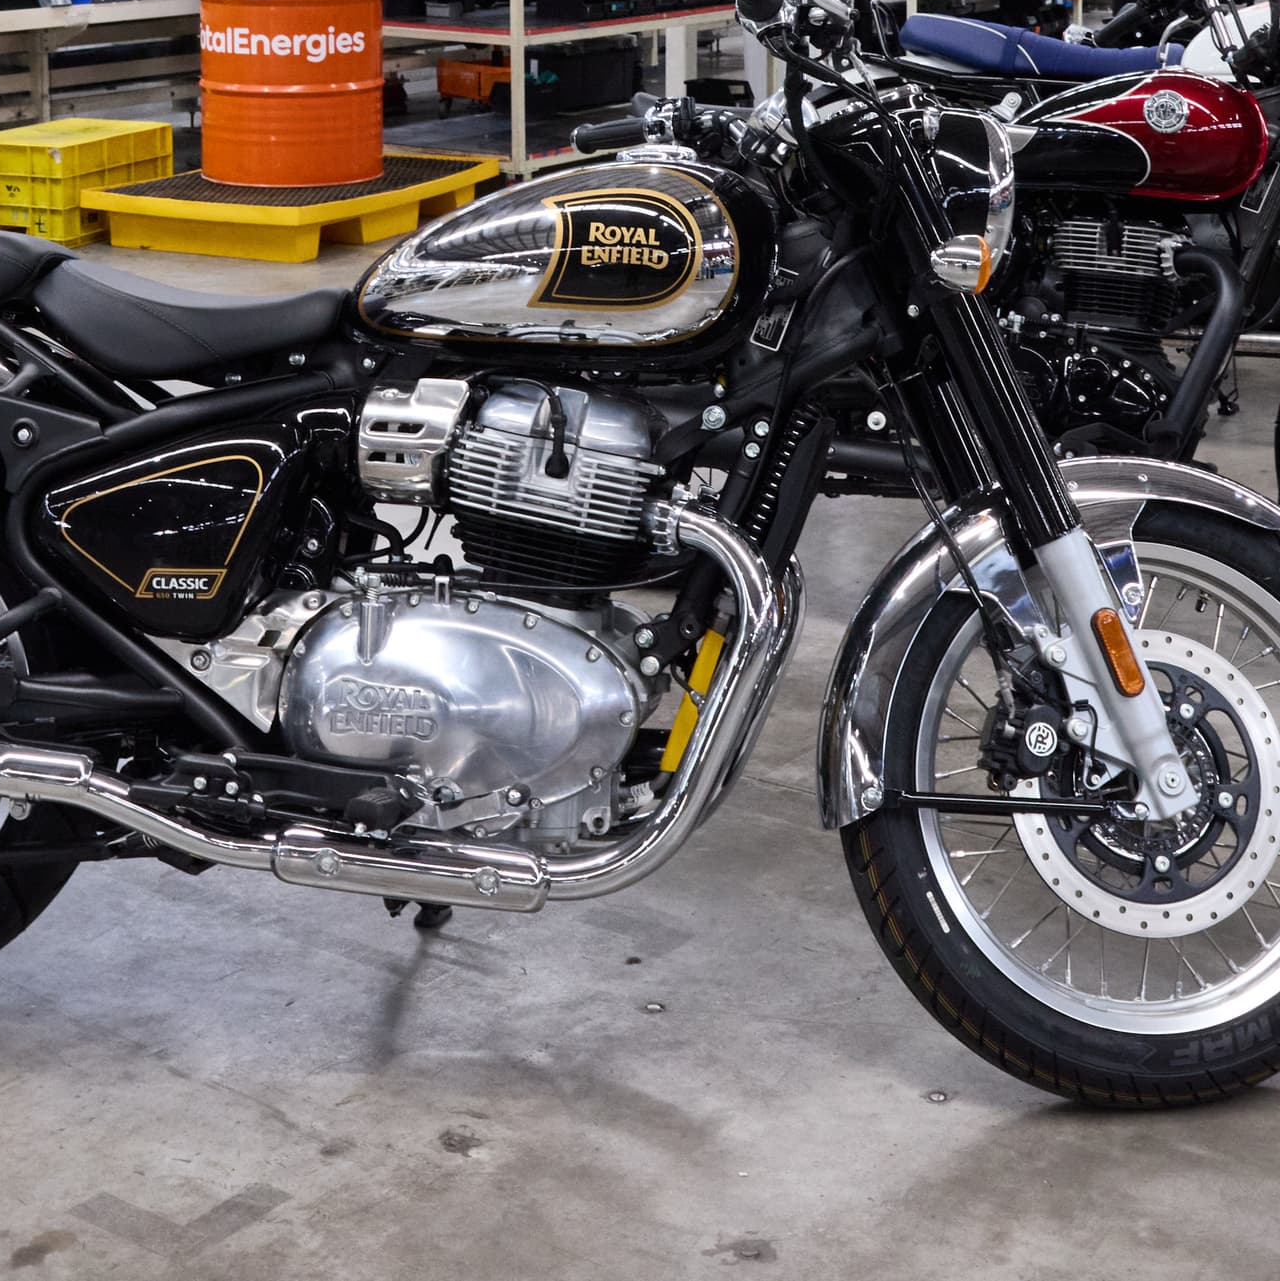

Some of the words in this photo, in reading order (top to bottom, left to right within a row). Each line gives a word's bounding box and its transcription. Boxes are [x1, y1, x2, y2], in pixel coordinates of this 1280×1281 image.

[201, 24, 365, 63] otalEnergies
[588, 222, 660, 245] ROYAL
[581, 245, 669, 270] ENFIELD
[152, 577, 209, 590] CLASSIC
[340, 678, 432, 711] ROYAL
[329, 708, 440, 743] ENFIELD
